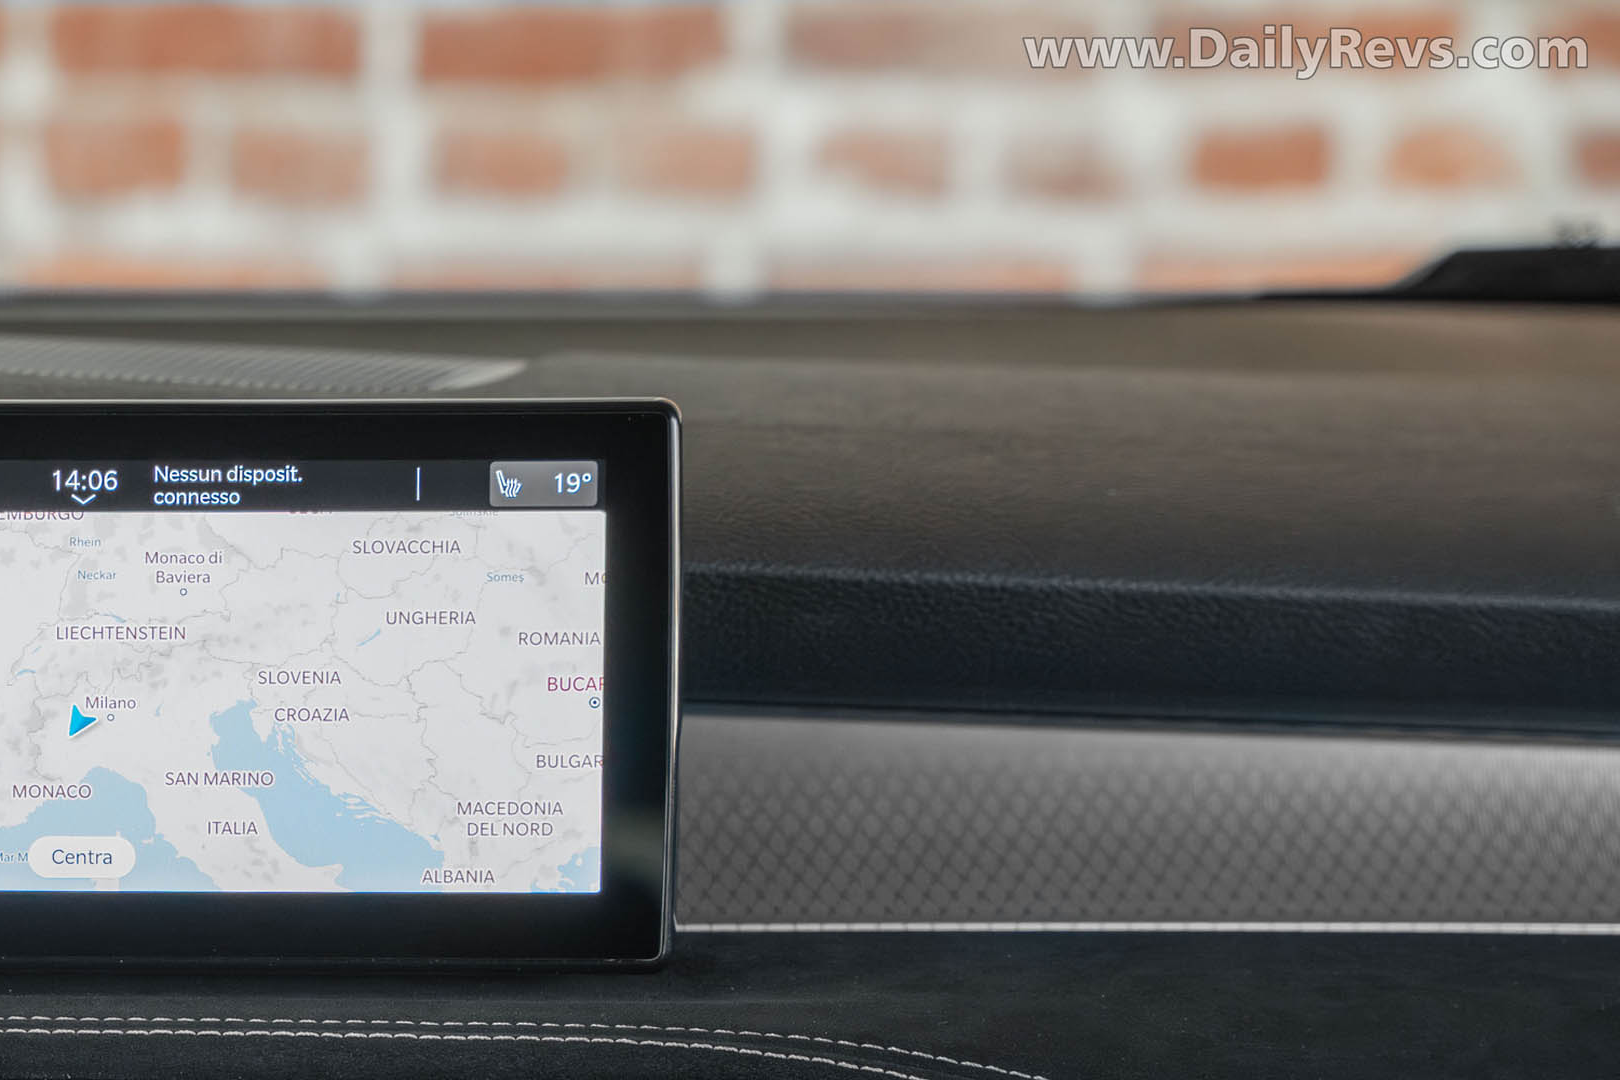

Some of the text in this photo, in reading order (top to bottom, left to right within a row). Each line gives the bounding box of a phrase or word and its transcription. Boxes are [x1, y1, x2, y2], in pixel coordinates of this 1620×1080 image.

[52, 470, 119, 492] 14:06
[153, 465, 303, 487] Nessun disposit.
[554, 472, 592, 494] 19°
[153, 490, 241, 505] connesso
[352, 540, 461, 555] SLOVACCHIA
[144, 551, 223, 565] Monaco di
[77, 570, 117, 580] Neckar
[155, 571, 211, 584] Baviera
[385, 611, 476, 626] UNGHERIA
[56, 626, 186, 641] LIECHTENSTEIN
[518, 631, 602, 647] ROMANIA
[258, 671, 341, 685] SLOVENIA
[85, 696, 137, 711] Milano
[274, 708, 350, 723] CROAZIA
[165, 772, 275, 787] SAN MARINO
[12, 784, 93, 799] MONACO
[456, 802, 563, 816] MACEDONIA
[207, 821, 258, 836] ITALIA
[467, 822, 554, 837] DEL NORD
[51, 849, 113, 866] Centra
[422, 870, 496, 885] ALBANIA
